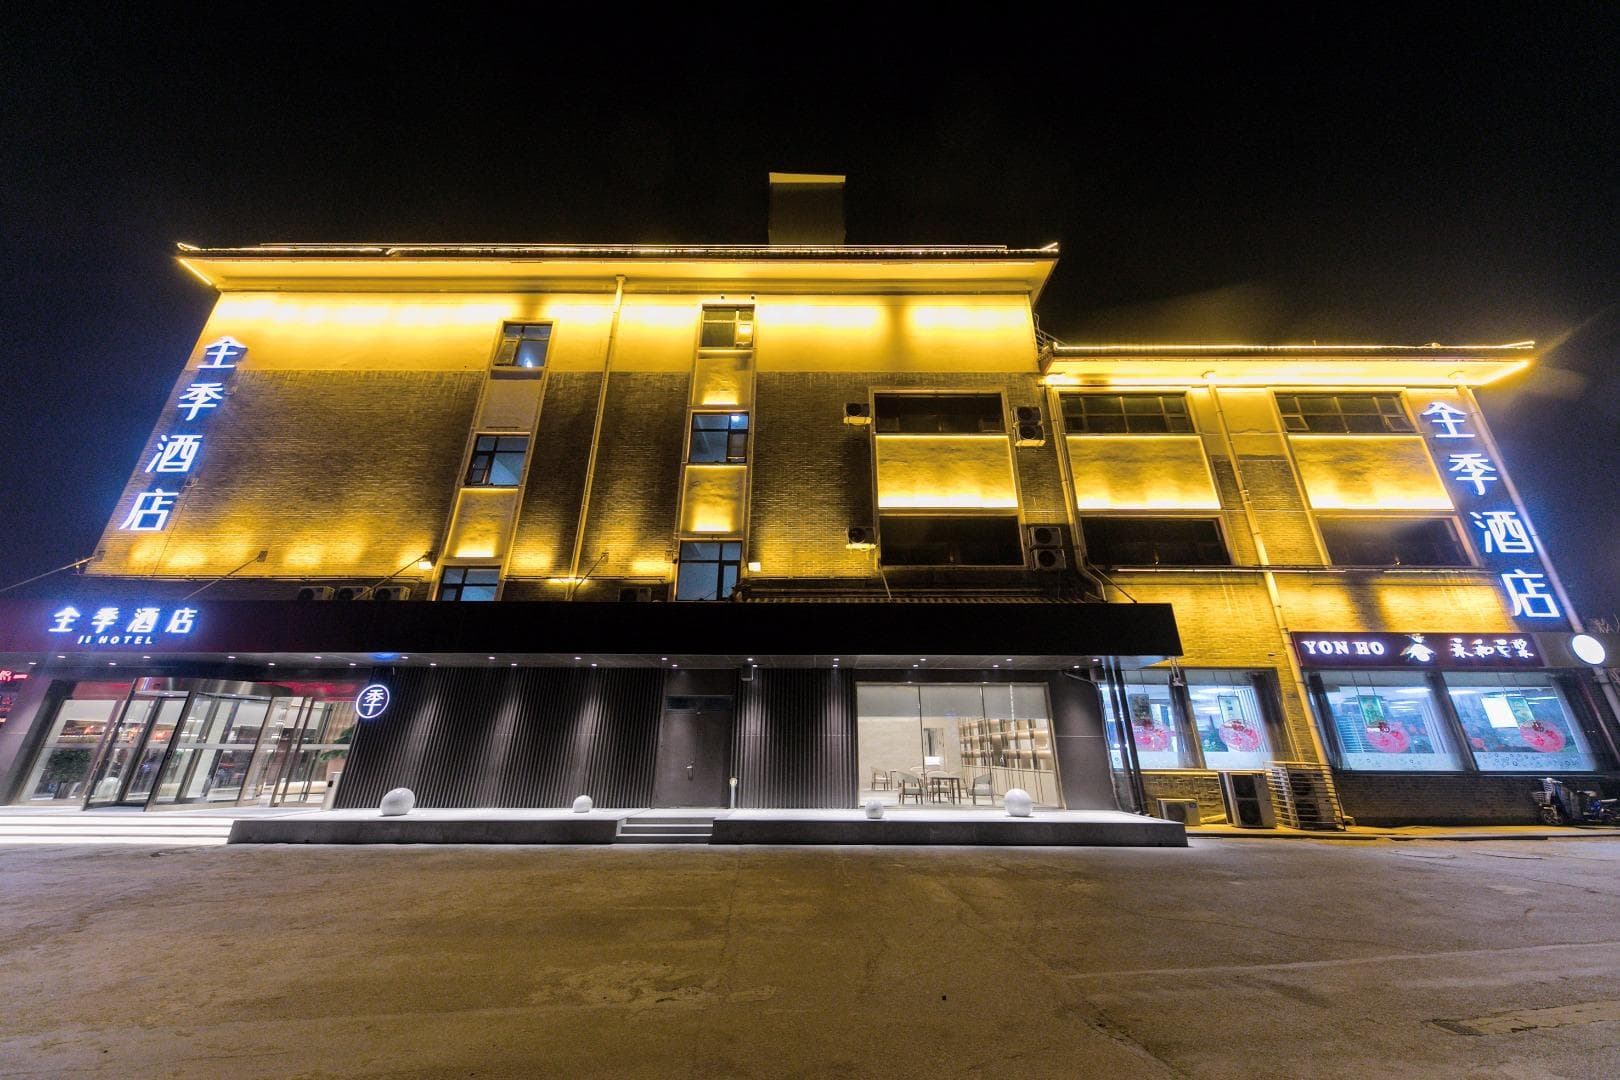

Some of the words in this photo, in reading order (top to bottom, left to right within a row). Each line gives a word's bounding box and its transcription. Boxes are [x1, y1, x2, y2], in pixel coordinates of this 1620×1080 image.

[118, 336, 247, 531] 全季酒店
[1421, 402, 1560, 618] 全季酒店
[48, 606, 198, 634] 全季酒店
[98, 635, 153, 644] HOTEL
[1301, 640, 1350, 655] YON
[1352, 640, 1385, 655] HO
